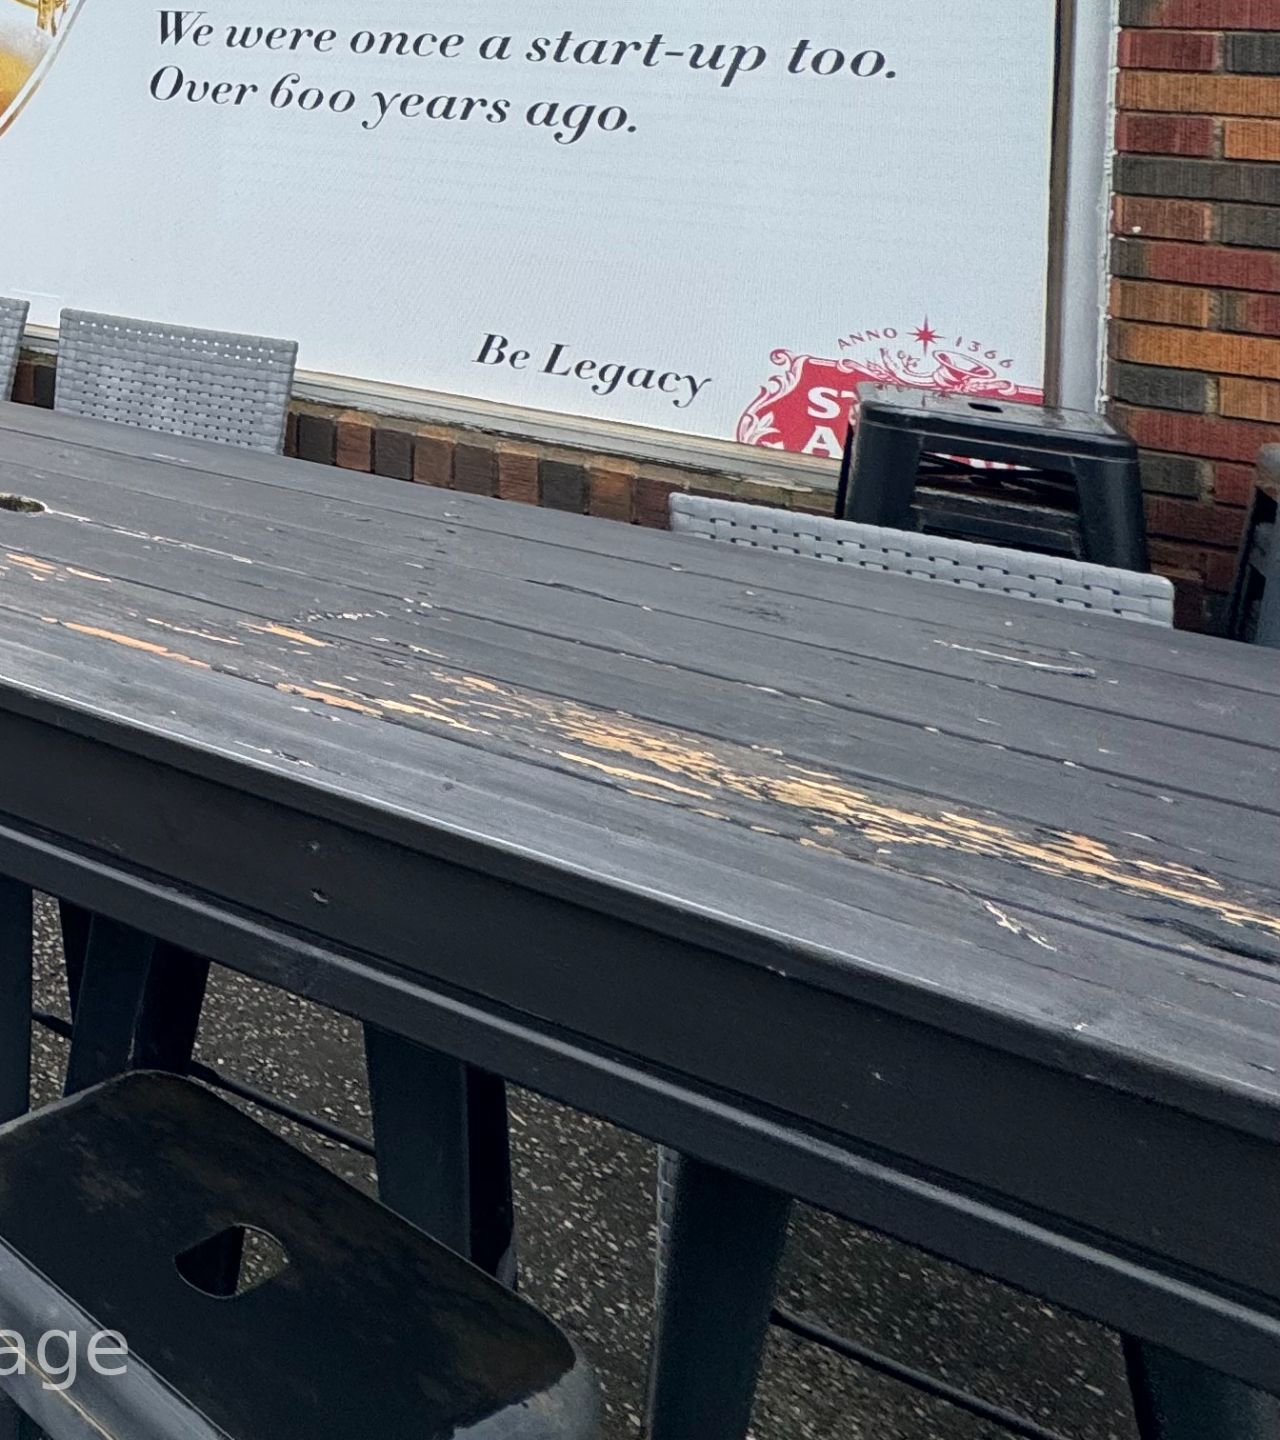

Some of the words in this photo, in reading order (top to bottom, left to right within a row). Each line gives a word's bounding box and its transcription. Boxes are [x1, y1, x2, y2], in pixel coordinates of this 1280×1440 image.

[155, 9, 214, 48] We
[224, 23, 338, 54] were
[349, 28, 465, 59] once
[478, 32, 512, 61] a
[525, 30, 768, 88] start-up
[787, 36, 897, 80] too.
[149, 64, 258, 110] Over
[269, 73, 357, 114] 600
[361, 87, 512, 130] years
[526, 101, 638, 144] ago.
[471, 332, 530, 370] Be
[537, 341, 713, 409] Legacy
[837, 327, 898, 351] ANNO
[955, 335, 1014, 369] 1366
